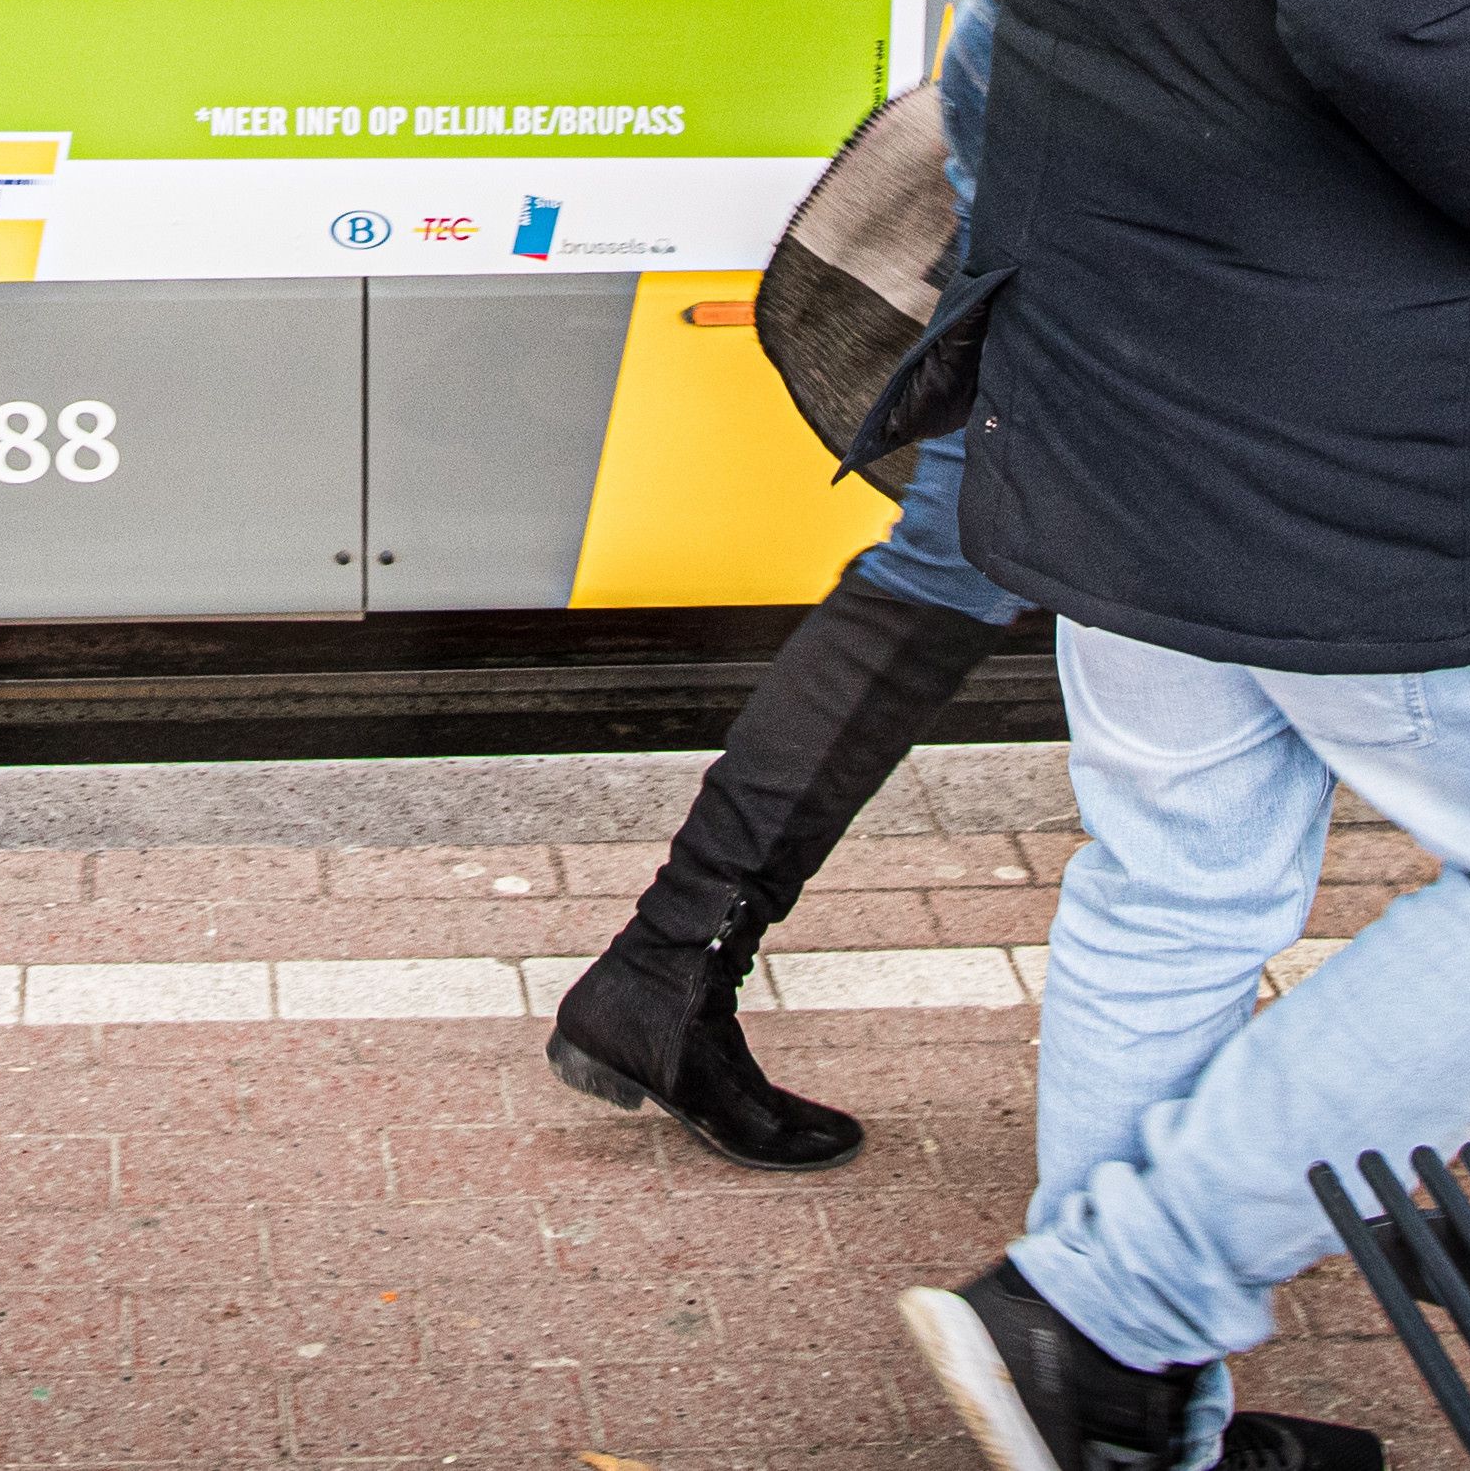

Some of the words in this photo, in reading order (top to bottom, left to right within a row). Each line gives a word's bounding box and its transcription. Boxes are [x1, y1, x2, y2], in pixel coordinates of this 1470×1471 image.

[295, 106, 360, 136] INFO
[368, 106, 408, 136] OP
[414, 104, 685, 137] DELIJN.BE/BRUPASS
[422, 217, 473, 242] TEC
